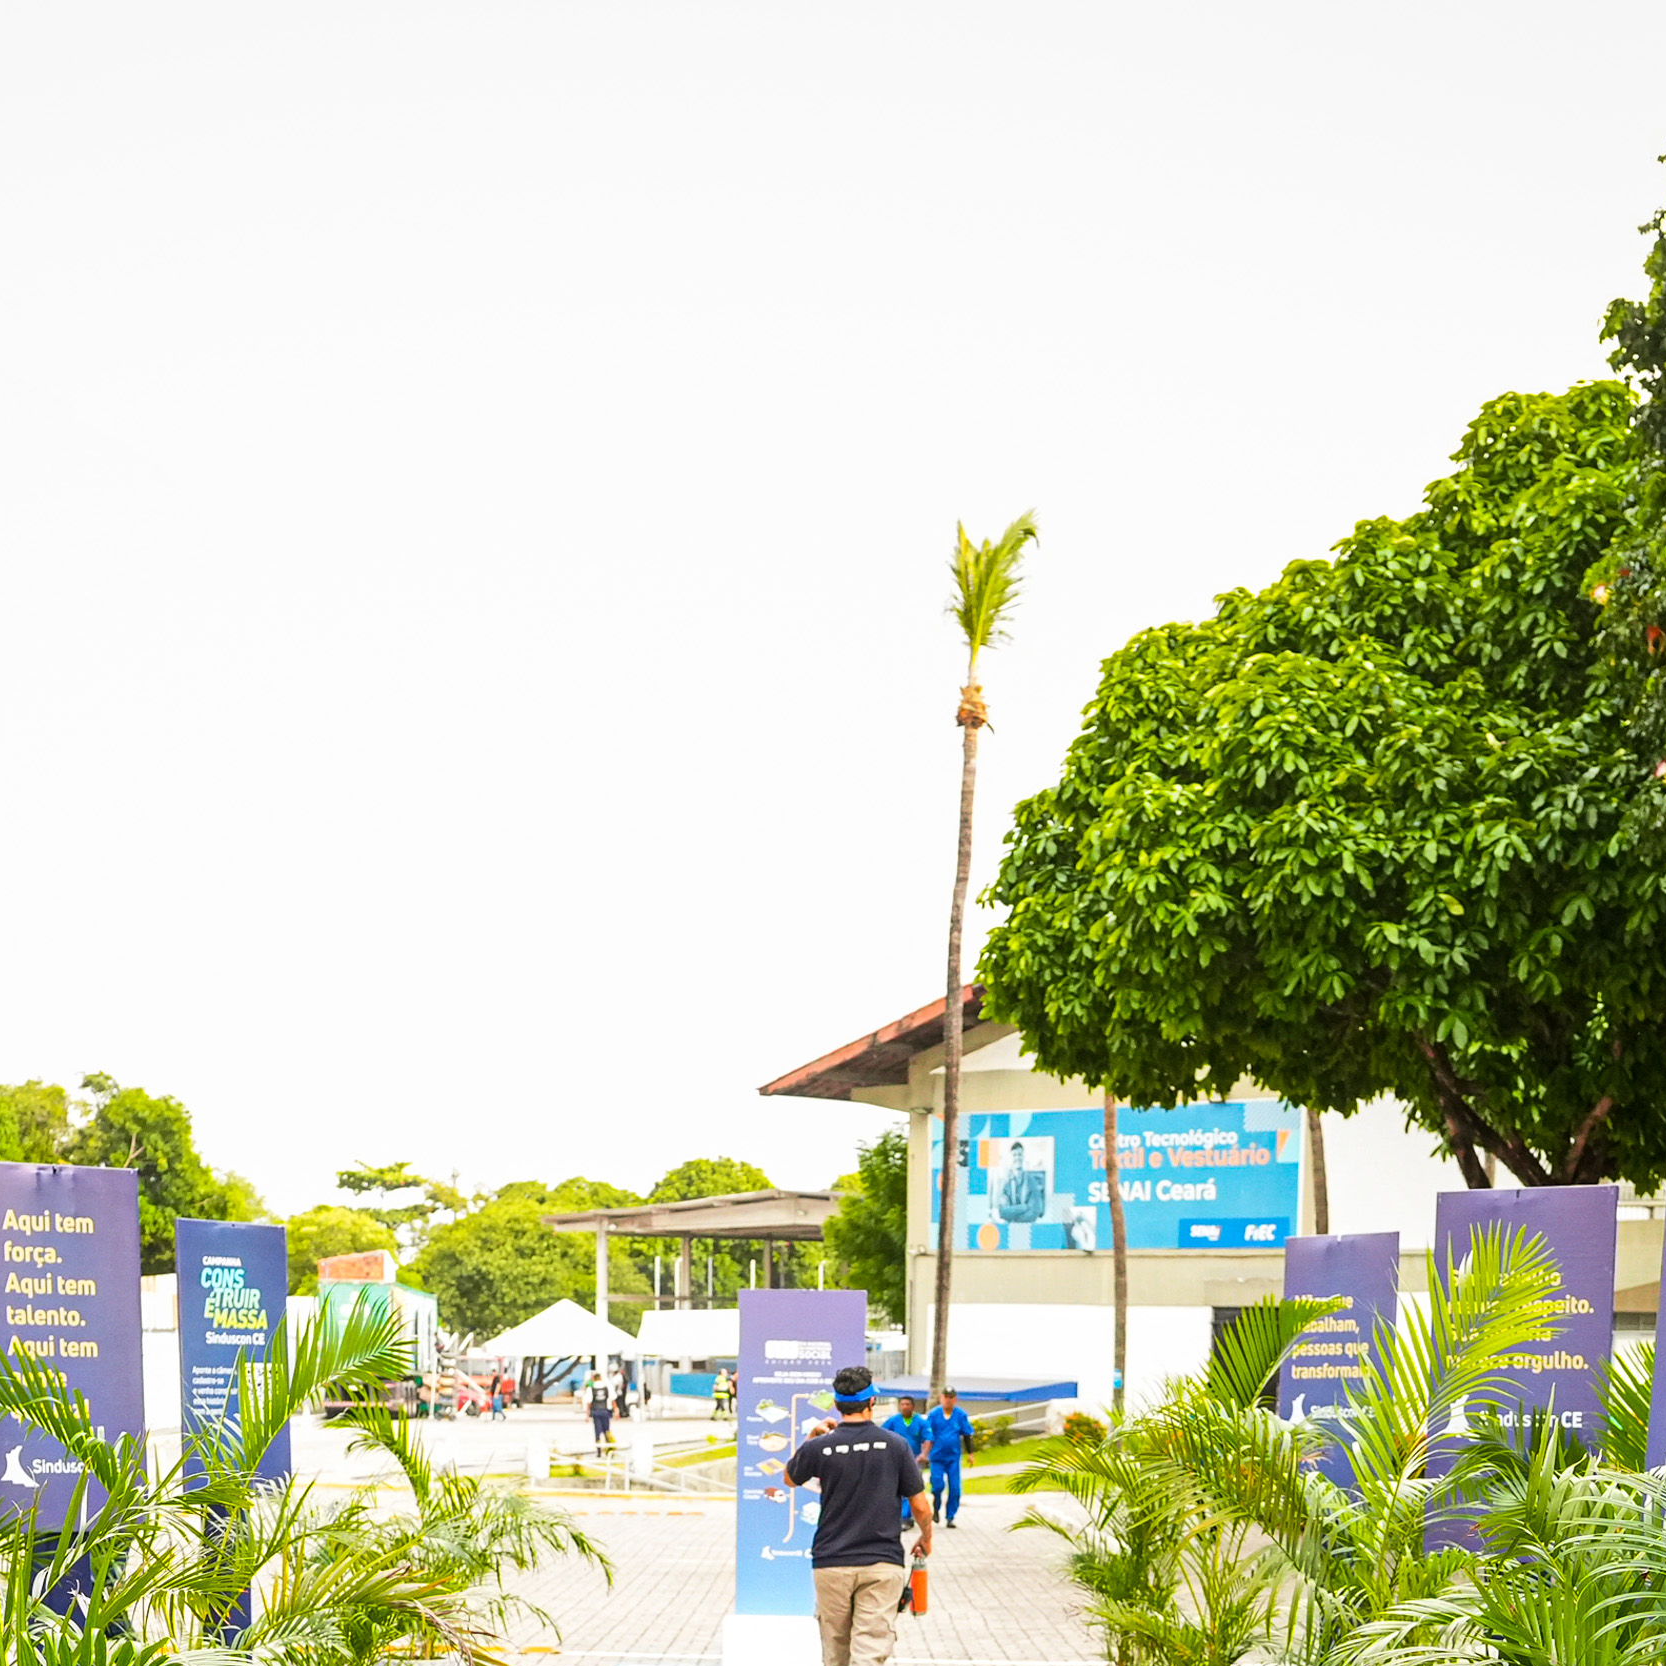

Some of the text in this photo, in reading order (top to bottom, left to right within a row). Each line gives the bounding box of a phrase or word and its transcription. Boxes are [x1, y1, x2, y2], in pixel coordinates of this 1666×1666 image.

[1143, 1128, 1239, 1149] Tecnológico
[1149, 1151, 1163, 1168] e
[1168, 1142, 1271, 1168] Vestuário
[1156, 1178, 1217, 1201] Ceará
[2, 1208, 94, 1236] Aqui tem
[3, 1240, 63, 1269] força.
[4, 1272, 96, 1299] Aqui tem
[201, 1267, 245, 1289] CONS
[213, 1288, 261, 1308] TRUIR
[6, 1303, 86, 1327] talento.
[213, 1308, 268, 1329] MASSA
[7, 1334, 99, 1361] Aqui tem
[205, 1331, 265, 1345] Sinduscon CE
[1561, 1411, 1583, 1429] CE
[32, 1458, 98, 1474] Sindusc
